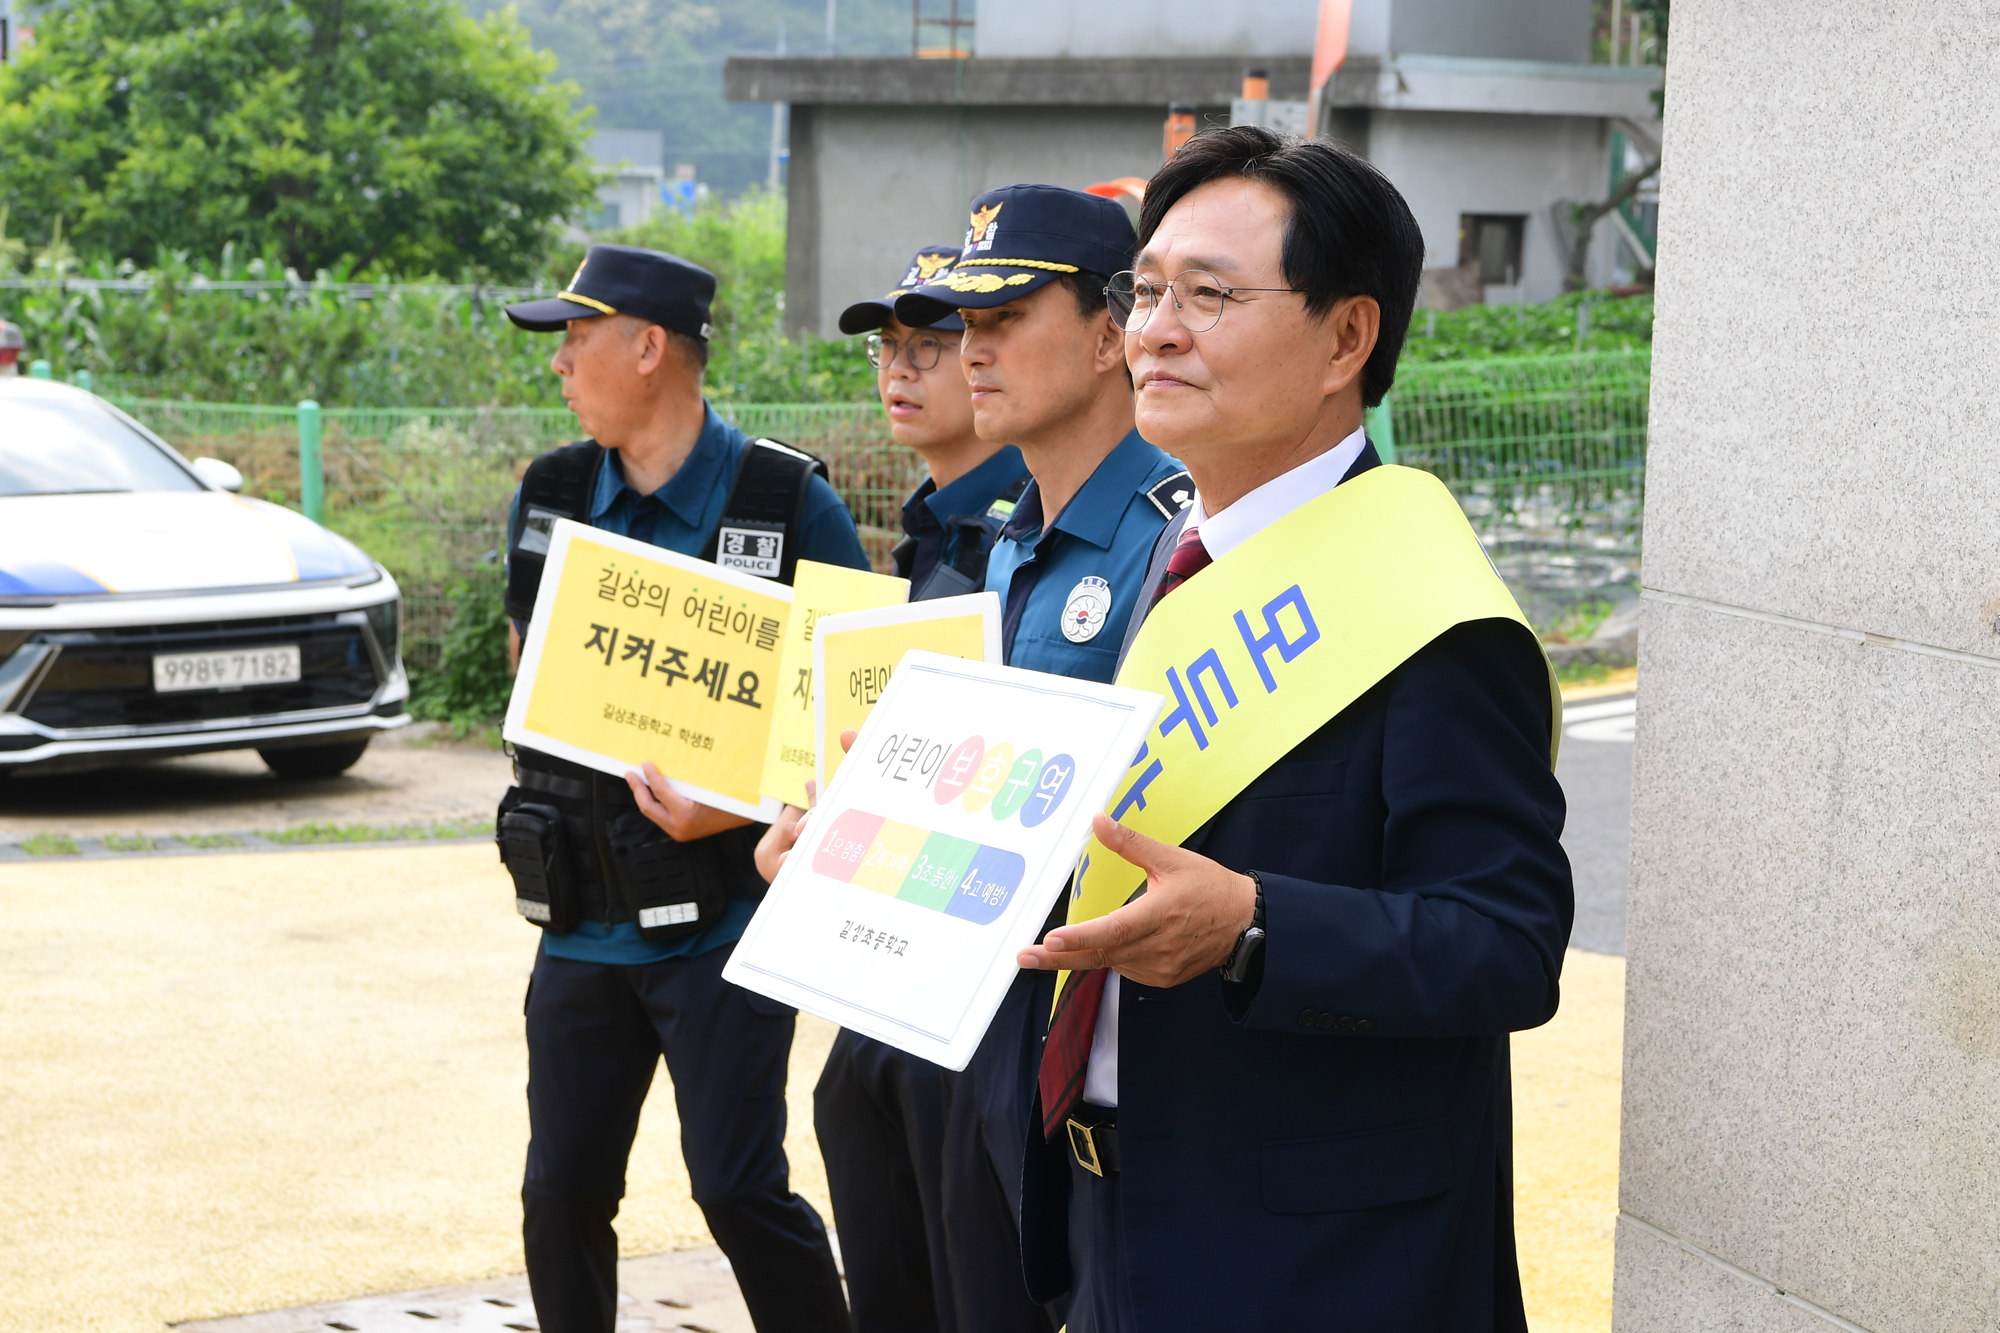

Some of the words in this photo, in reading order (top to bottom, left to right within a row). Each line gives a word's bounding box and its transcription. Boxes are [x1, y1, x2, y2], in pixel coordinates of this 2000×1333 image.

[724, 557, 773, 571] POLICE
[726, 533, 777, 558] 경찰
[597, 567, 670, 617] 길상의
[683, 595, 780, 652] 어린이를
[164, 652, 292, 685] 9987182
[584, 622, 762, 710] 지켜주세요
[603, 703, 673, 737] 길상초등학교
[679, 728, 715, 752] 학생회
[839, 920, 909, 957] 길상초등학교
